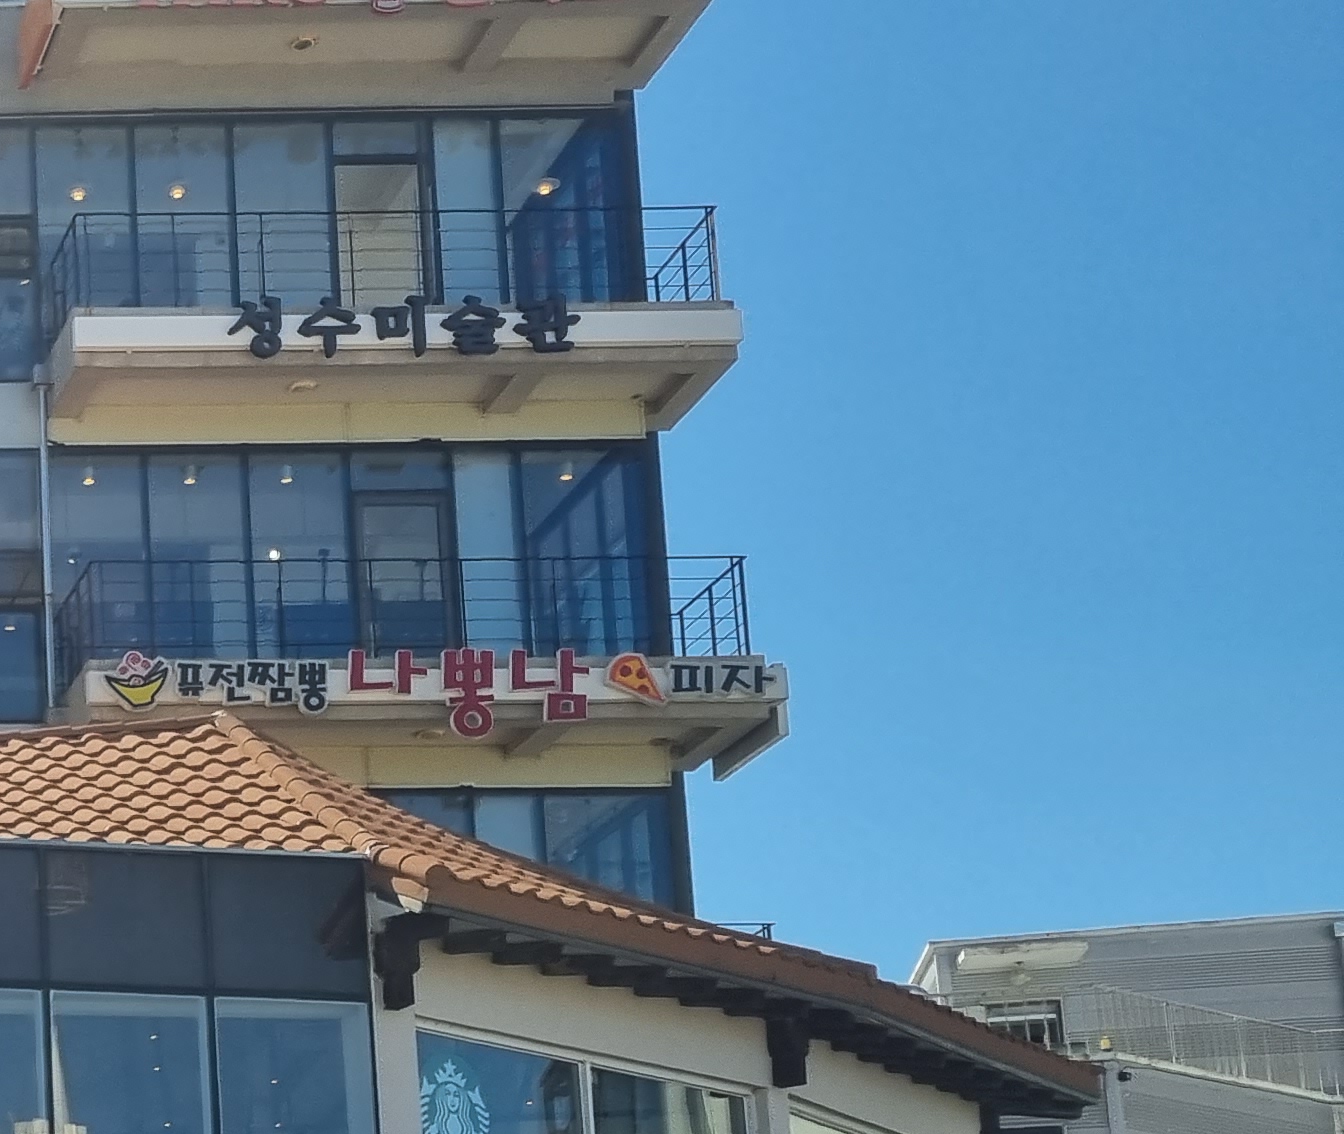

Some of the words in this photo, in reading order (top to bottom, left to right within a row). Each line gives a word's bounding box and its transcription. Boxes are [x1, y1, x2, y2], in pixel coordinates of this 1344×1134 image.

[226, 295, 581, 359] 성수미술관
[177, 661, 326, 711] 퓨전짬뽕
[349, 648, 589, 737] 나뽕남
[670, 664, 775, 693] 피자
